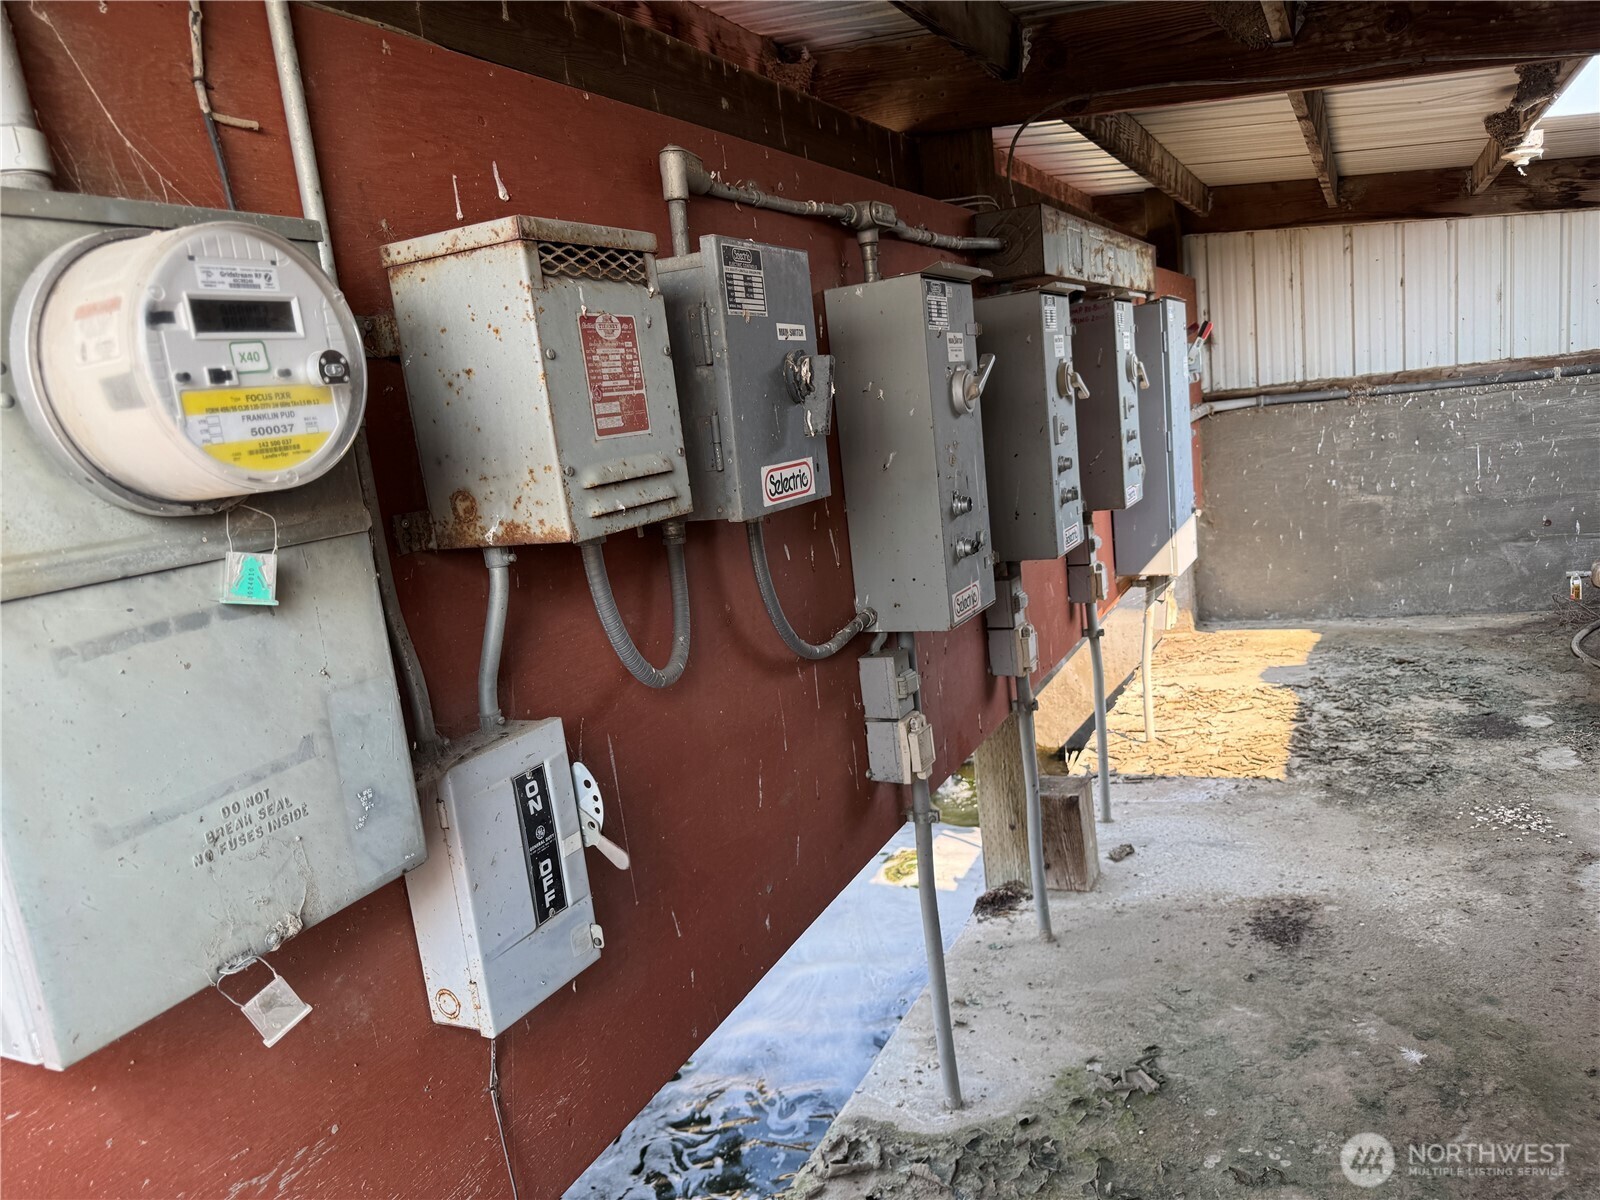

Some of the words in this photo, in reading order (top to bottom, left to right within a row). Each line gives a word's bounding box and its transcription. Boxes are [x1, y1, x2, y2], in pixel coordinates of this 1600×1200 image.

[238, 351, 261, 363] X40
[245, 394, 273, 403] FOCUS
[241, 413, 279, 423] FRANKLIN
[280, 410, 296, 419] PUD
[250, 424, 295, 437] 500037
[769, 469, 809, 497] Selectric
[956, 590, 978, 614] Selectric
[221, 801, 241, 819] DO
[243, 788, 270, 809] NOT
[257, 796, 293, 820] SEAL
[524, 779, 544, 815] ON
[192, 849, 214, 868] NO
[218, 824, 264, 856] FUSES
[266, 802, 309, 833] INSIDE
[539, 857, 556, 908] OFF
